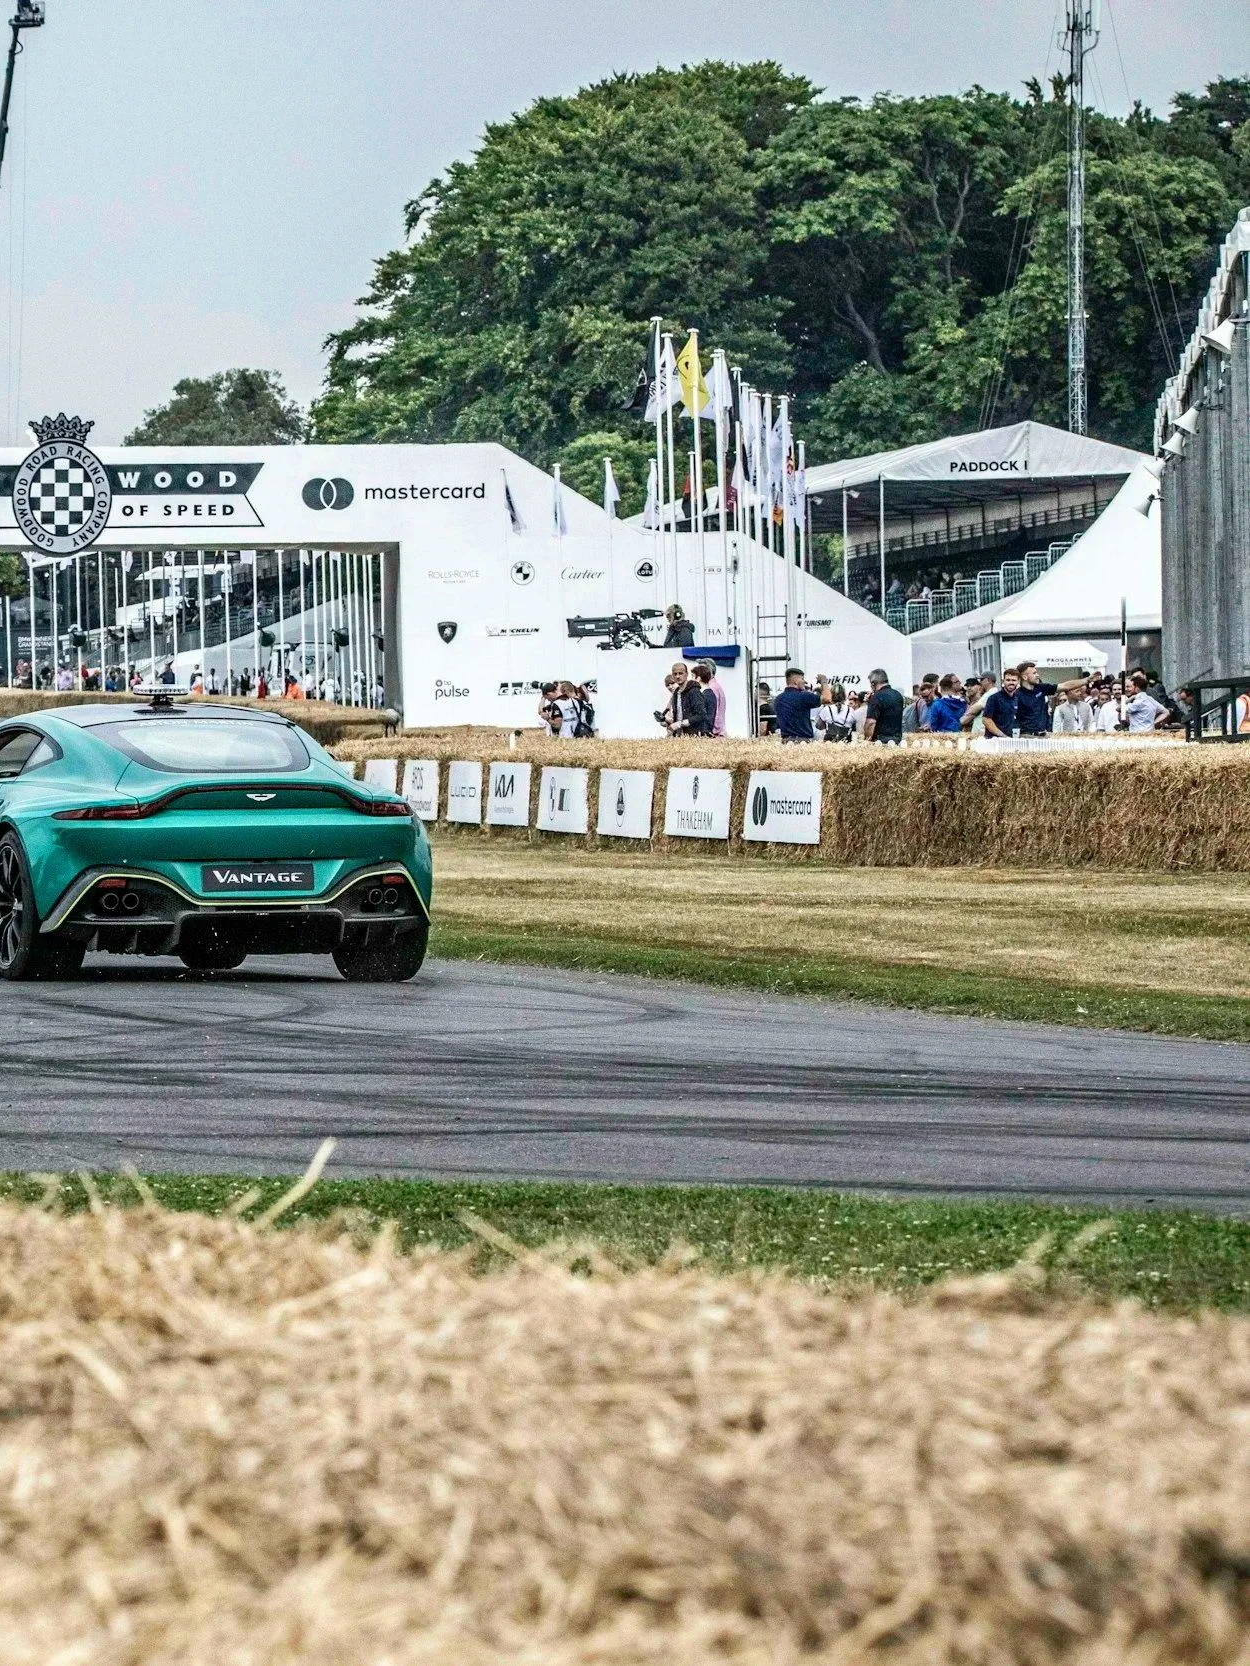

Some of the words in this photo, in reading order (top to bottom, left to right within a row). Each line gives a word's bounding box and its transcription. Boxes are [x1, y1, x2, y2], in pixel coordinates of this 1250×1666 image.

[25, 446, 57, 472] ROAD
[66, 446, 105, 485] RACING
[950, 460, 1019, 473] PADDOCK
[117, 470, 237, 490] WOOD
[364, 482, 486, 500] mastercard
[16, 477, 54, 547] GOODWOOD
[71, 491, 108, 548] COMPANY
[121, 505, 149, 518] OF
[163, 503, 236, 517] SPEED
[560, 566, 605, 581] Cartier
[435, 685, 470, 700] pulse
[450, 786, 477, 798] LUCID
[770, 796, 812, 816] mastercard
[676, 809, 714, 832] THAKEHAM
[212, 869, 305, 884] VANTAGE
